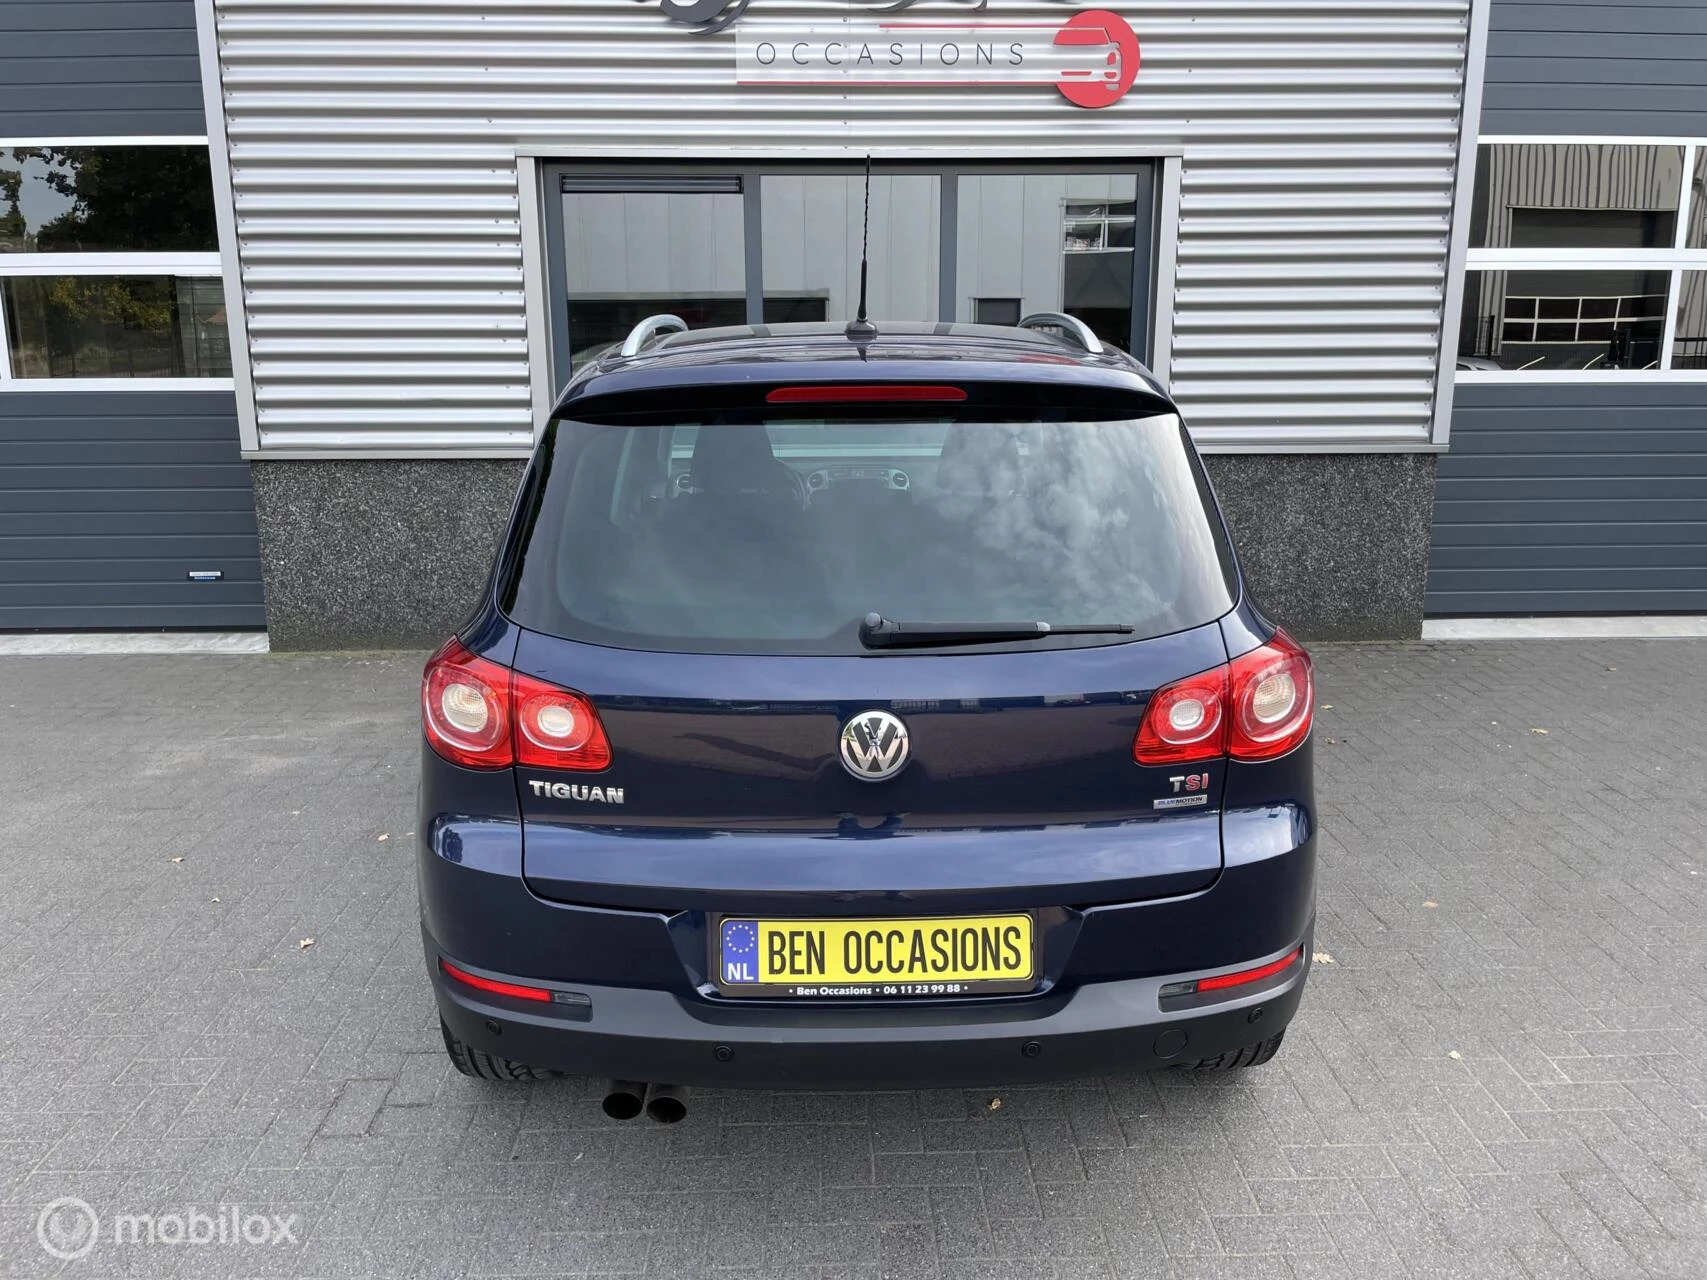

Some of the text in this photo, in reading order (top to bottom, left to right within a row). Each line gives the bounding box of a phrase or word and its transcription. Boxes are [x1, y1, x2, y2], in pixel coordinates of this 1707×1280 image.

[755, 41, 1026, 66] OCCASIONS
[528, 780, 625, 804] TIGUAN
[1169, 773, 1209, 792] TSI
[767, 926, 1022, 976] BEN OCCASIONS
[727, 962, 754, 981] NL
[796, 984, 960, 996] Ben Occasions 06 11 23 99 88
